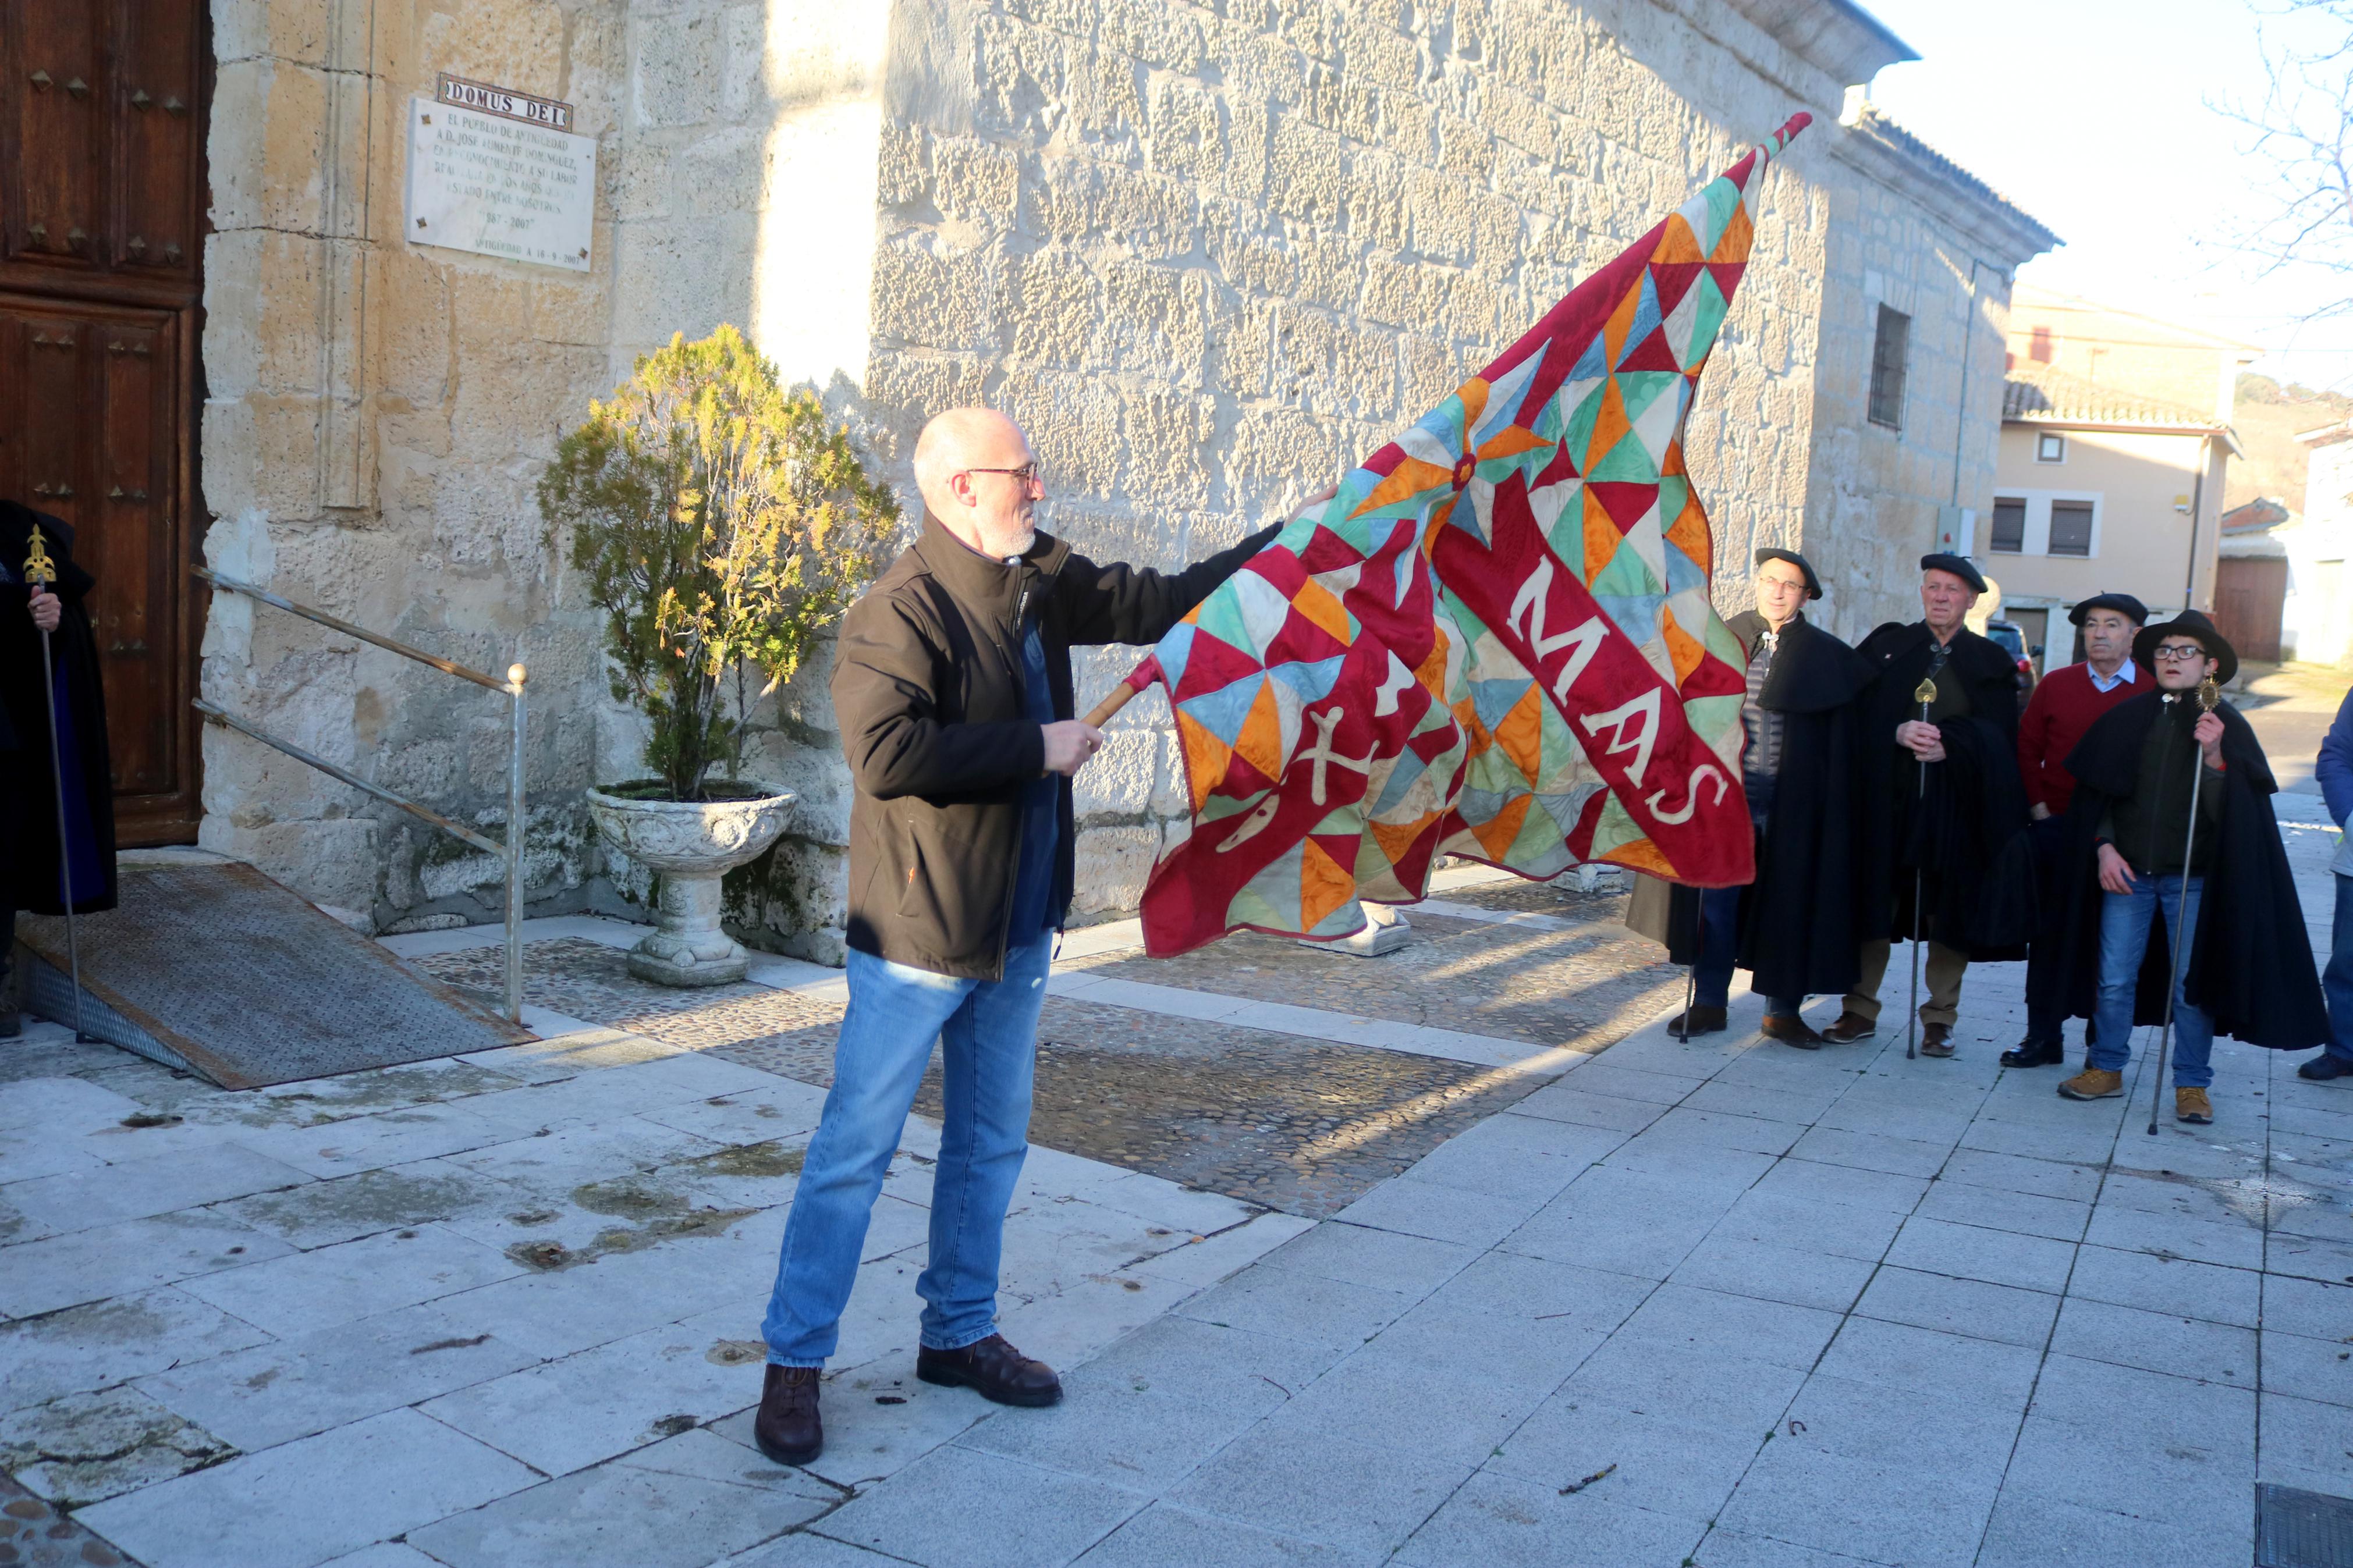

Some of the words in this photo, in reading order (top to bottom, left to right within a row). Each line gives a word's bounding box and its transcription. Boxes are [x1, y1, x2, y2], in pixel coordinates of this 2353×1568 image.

[451, 83, 513, 112] DOMUS
[526, 100, 559, 123] DEI
[436, 127, 442, 140] A
[445, 129, 455, 143] D.
[448, 112, 459, 126] EL
[462, 116, 497, 135] PUEBLO
[500, 125, 512, 138] DE
[433, 143, 443, 157] EN
[529, 165, 534, 176] A
[537, 166, 548, 179] SU
[550, 169, 577, 186] LABOR
[434, 161, 483, 182] REALADA
[485, 189, 512, 205] ENTRE
[526, 247, 531, 257] A
[537, 248, 545, 259] 16
[552, 251, 556, 261] 9
[563, 253, 580, 265] 2007
